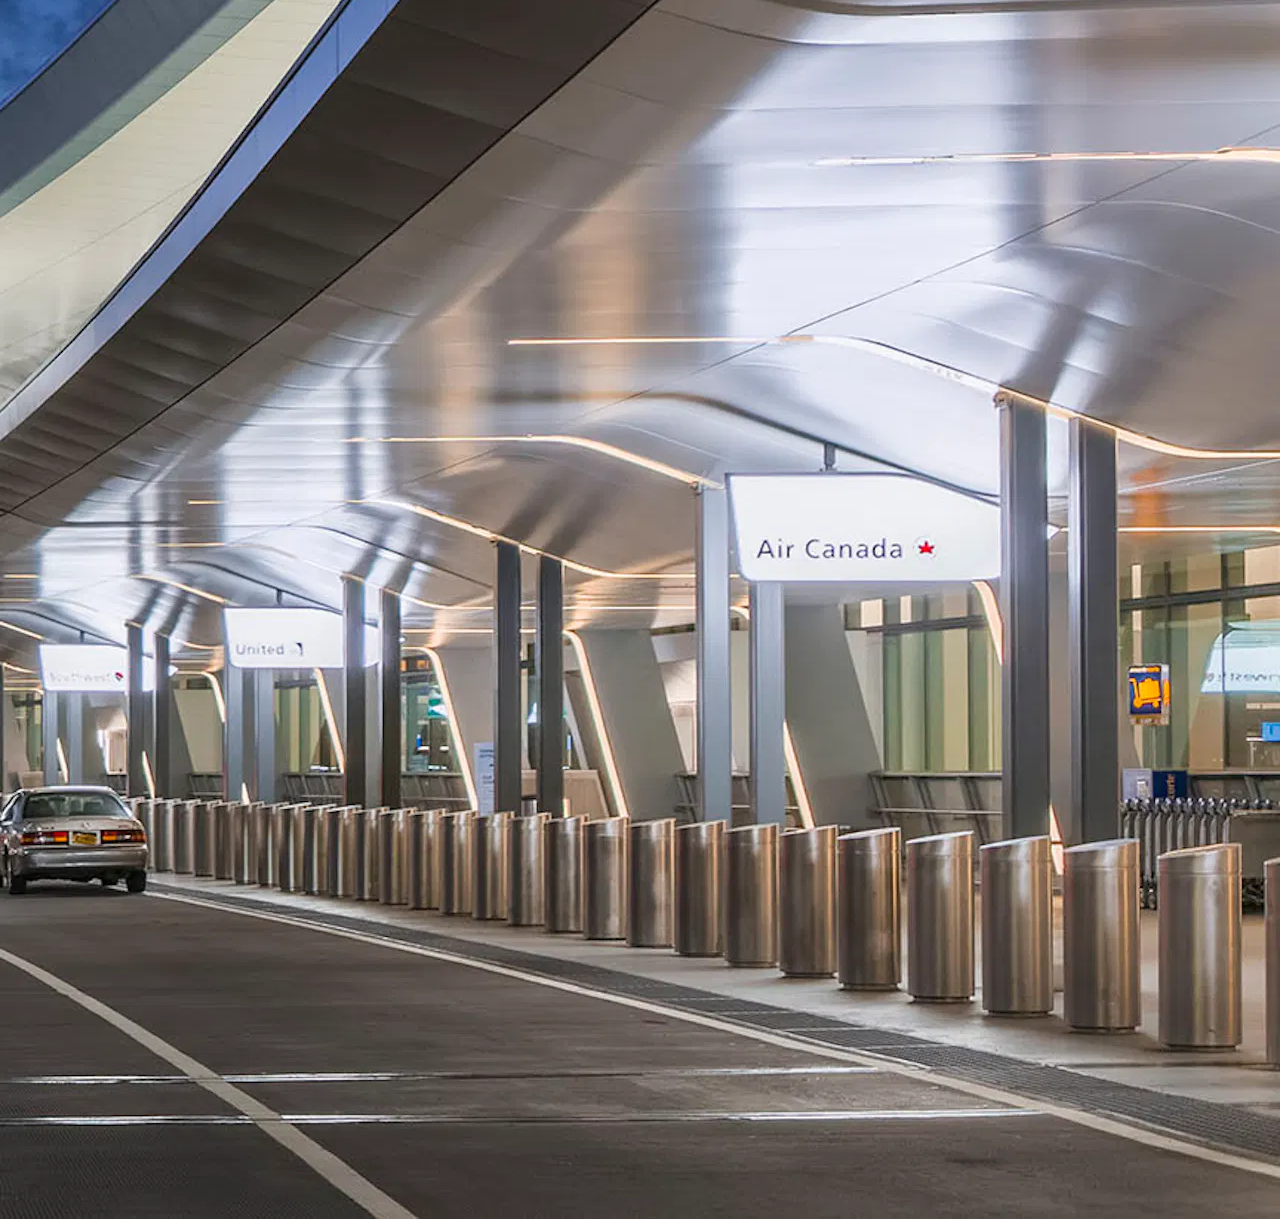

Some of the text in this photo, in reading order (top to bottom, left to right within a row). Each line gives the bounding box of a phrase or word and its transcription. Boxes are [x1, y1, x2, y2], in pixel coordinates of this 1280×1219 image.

[756, 537, 903, 559] Air Canada
[235, 642, 285, 655] United
